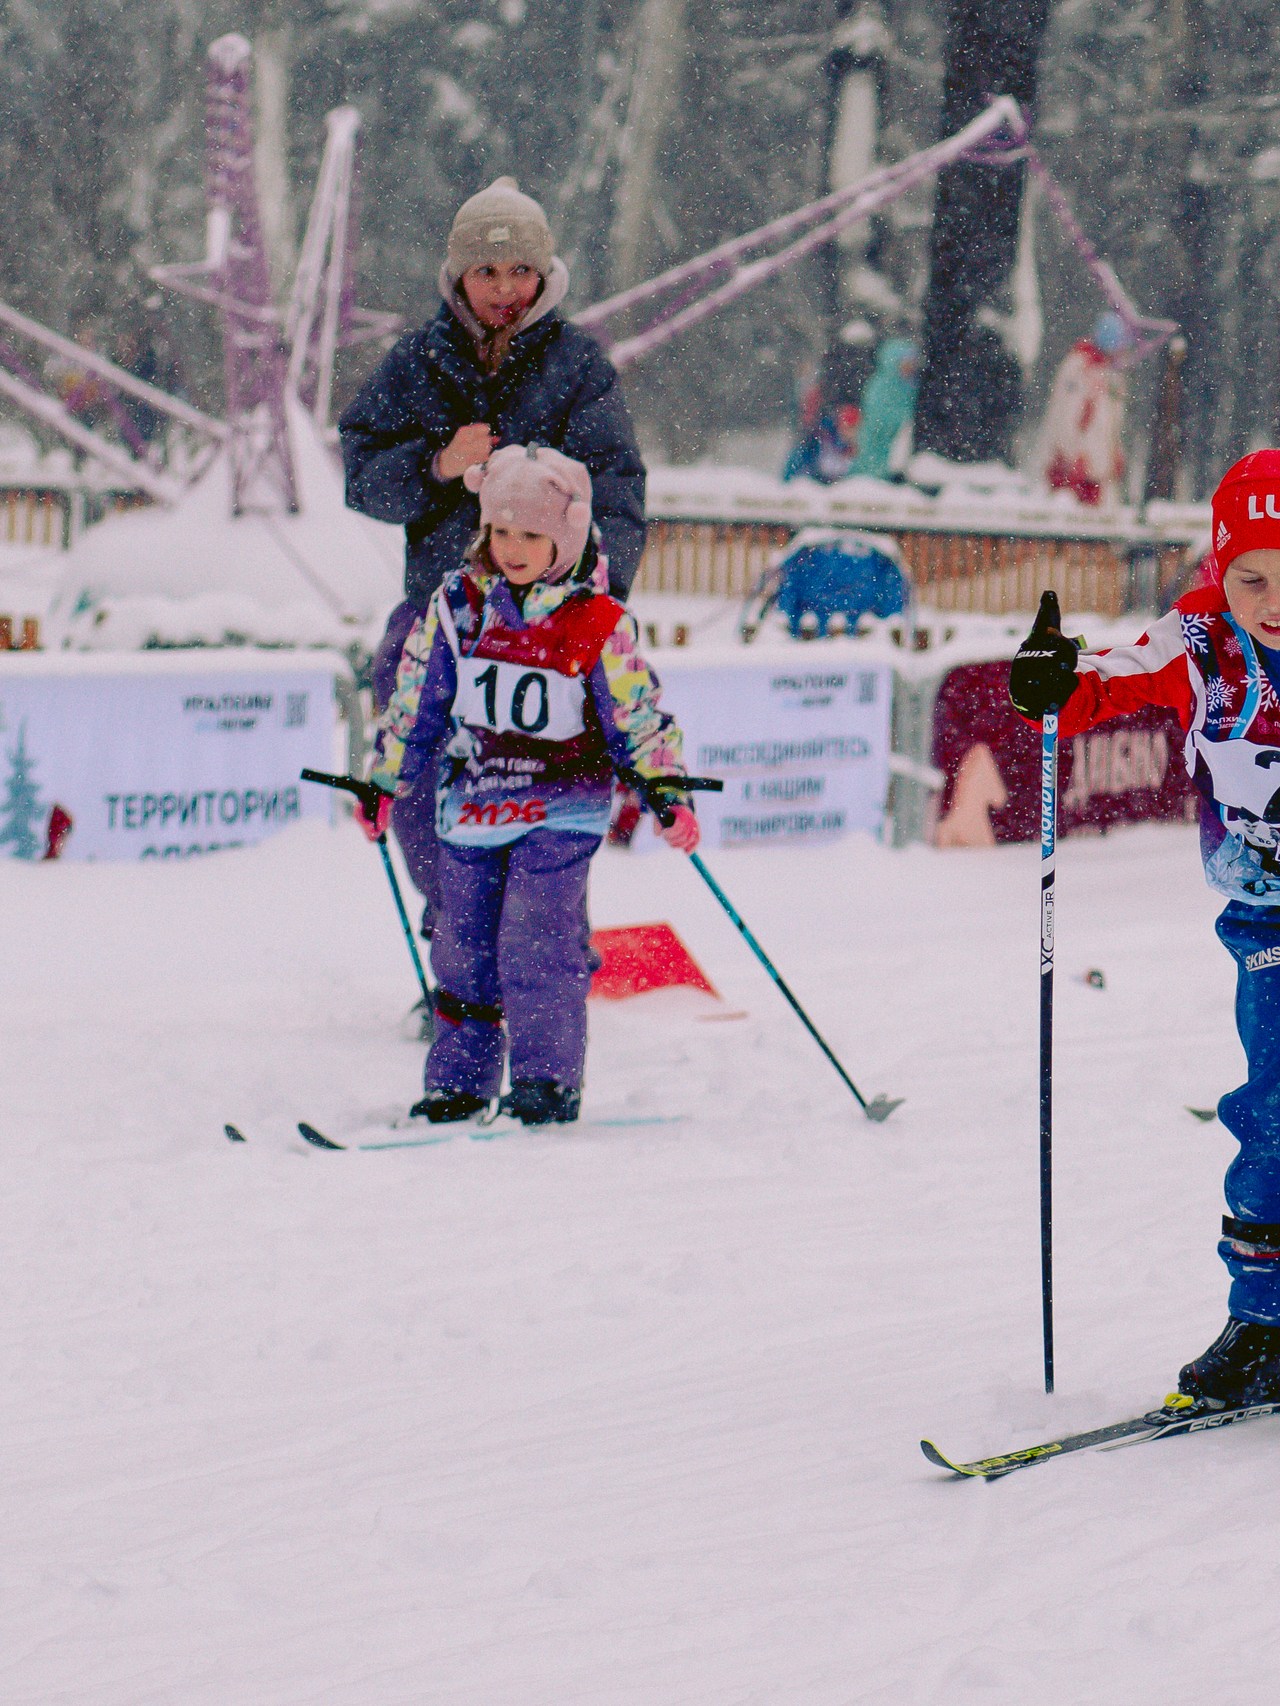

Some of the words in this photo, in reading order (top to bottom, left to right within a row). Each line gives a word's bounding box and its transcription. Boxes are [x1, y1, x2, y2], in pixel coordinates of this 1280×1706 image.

[1016, 650, 1057, 659] SWIX
[474, 664, 549, 733] 10
[106, 786, 300, 830] ТЕРРИТОРИЯ
[1042, 750, 1054, 847] NORDWAY
[1045, 892, 1054, 907] JR
[1042, 938, 1054, 966] XC
